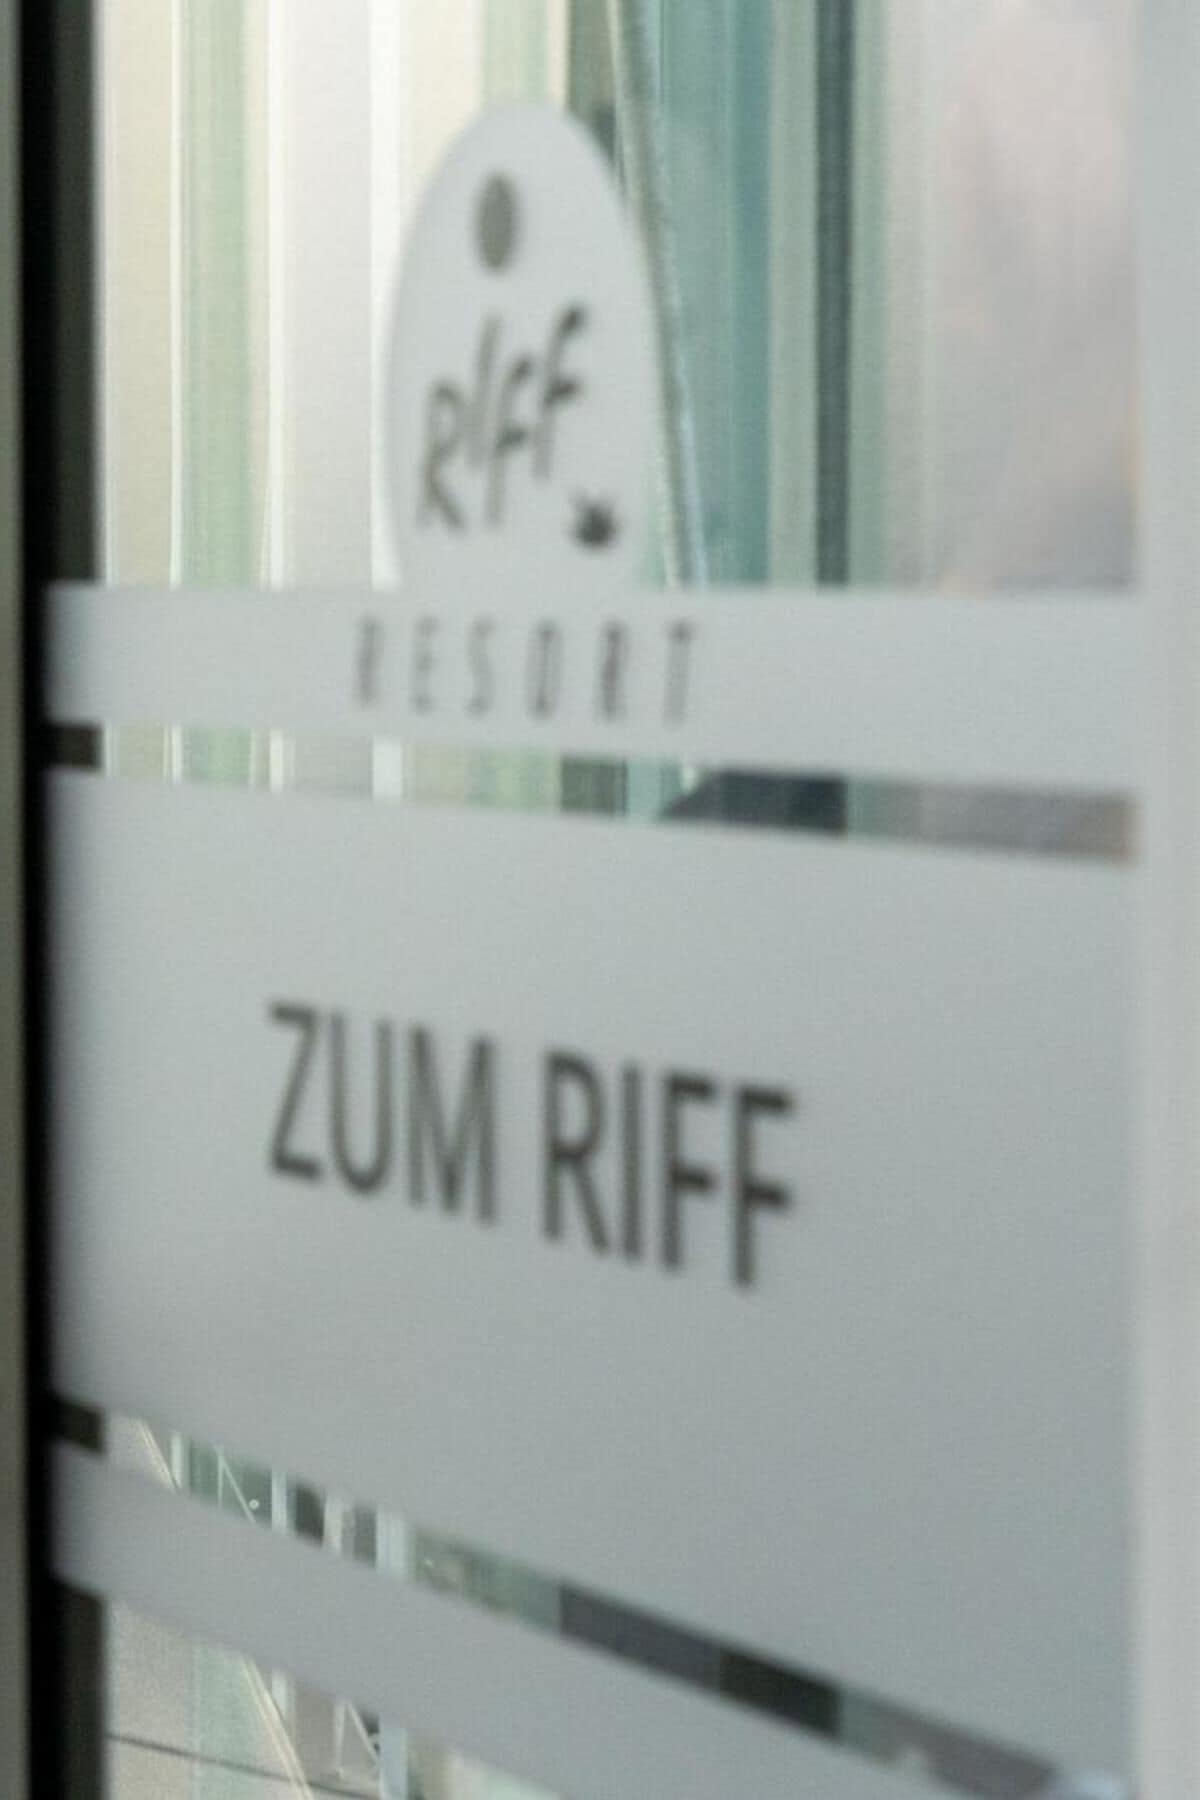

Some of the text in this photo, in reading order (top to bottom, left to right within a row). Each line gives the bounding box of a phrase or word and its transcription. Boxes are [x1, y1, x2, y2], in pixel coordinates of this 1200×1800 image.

[355, 614, 697, 728] RESORT
[266, 999, 797, 1290] ZUM RIFF
